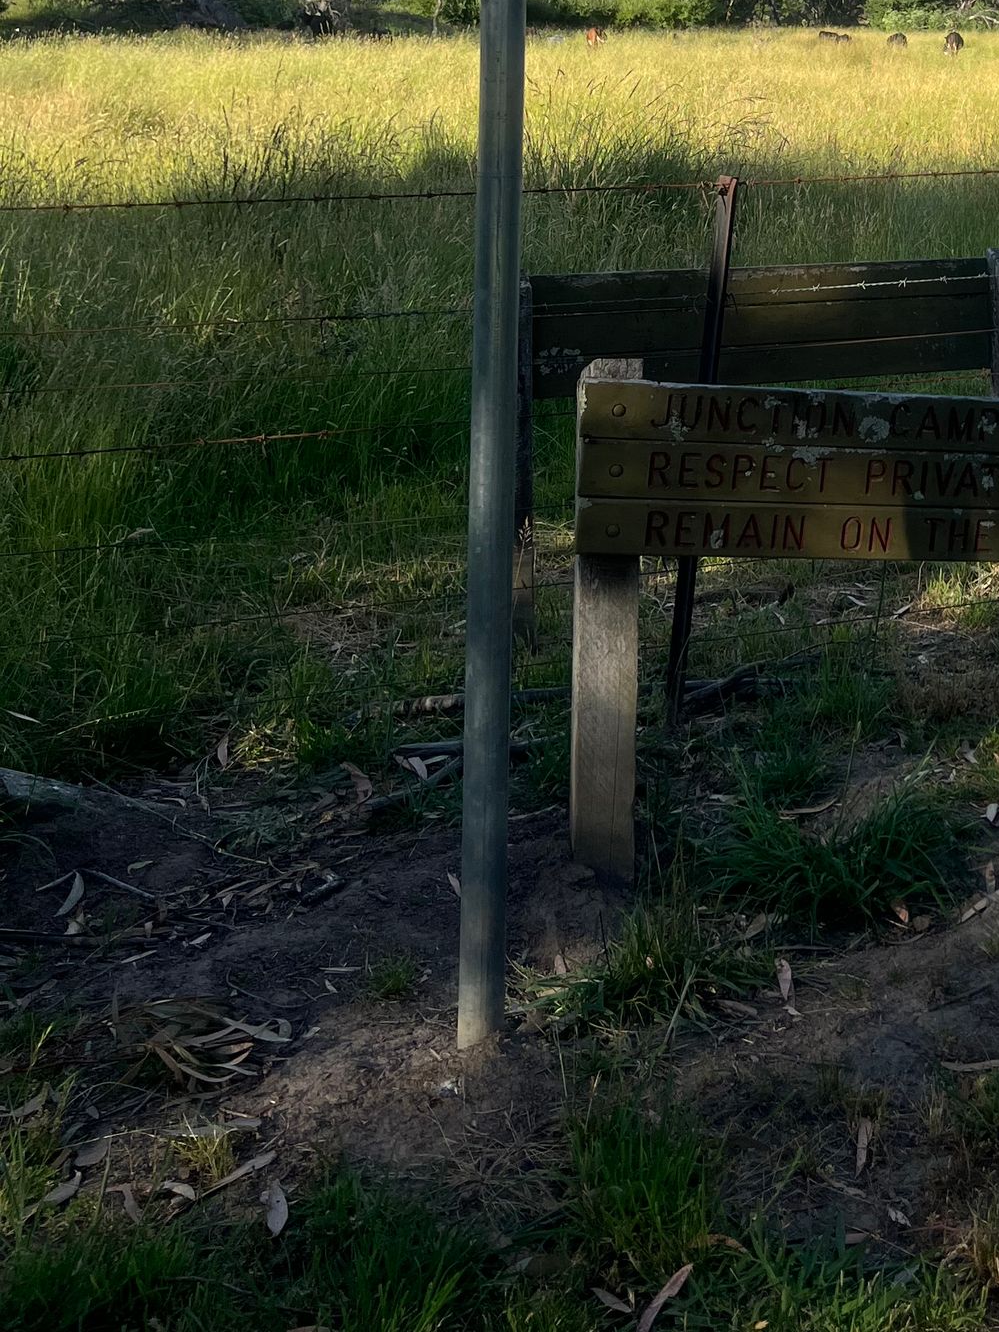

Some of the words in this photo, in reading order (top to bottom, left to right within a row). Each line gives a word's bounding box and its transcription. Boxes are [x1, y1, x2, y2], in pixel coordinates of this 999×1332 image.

[651, 394, 855, 439] JUNCTION
[647, 451, 833, 494] RESPECT
[644, 510, 806, 551] REMAIN
[840, 515, 893, 553] ON
[924, 517, 994, 554] THE
